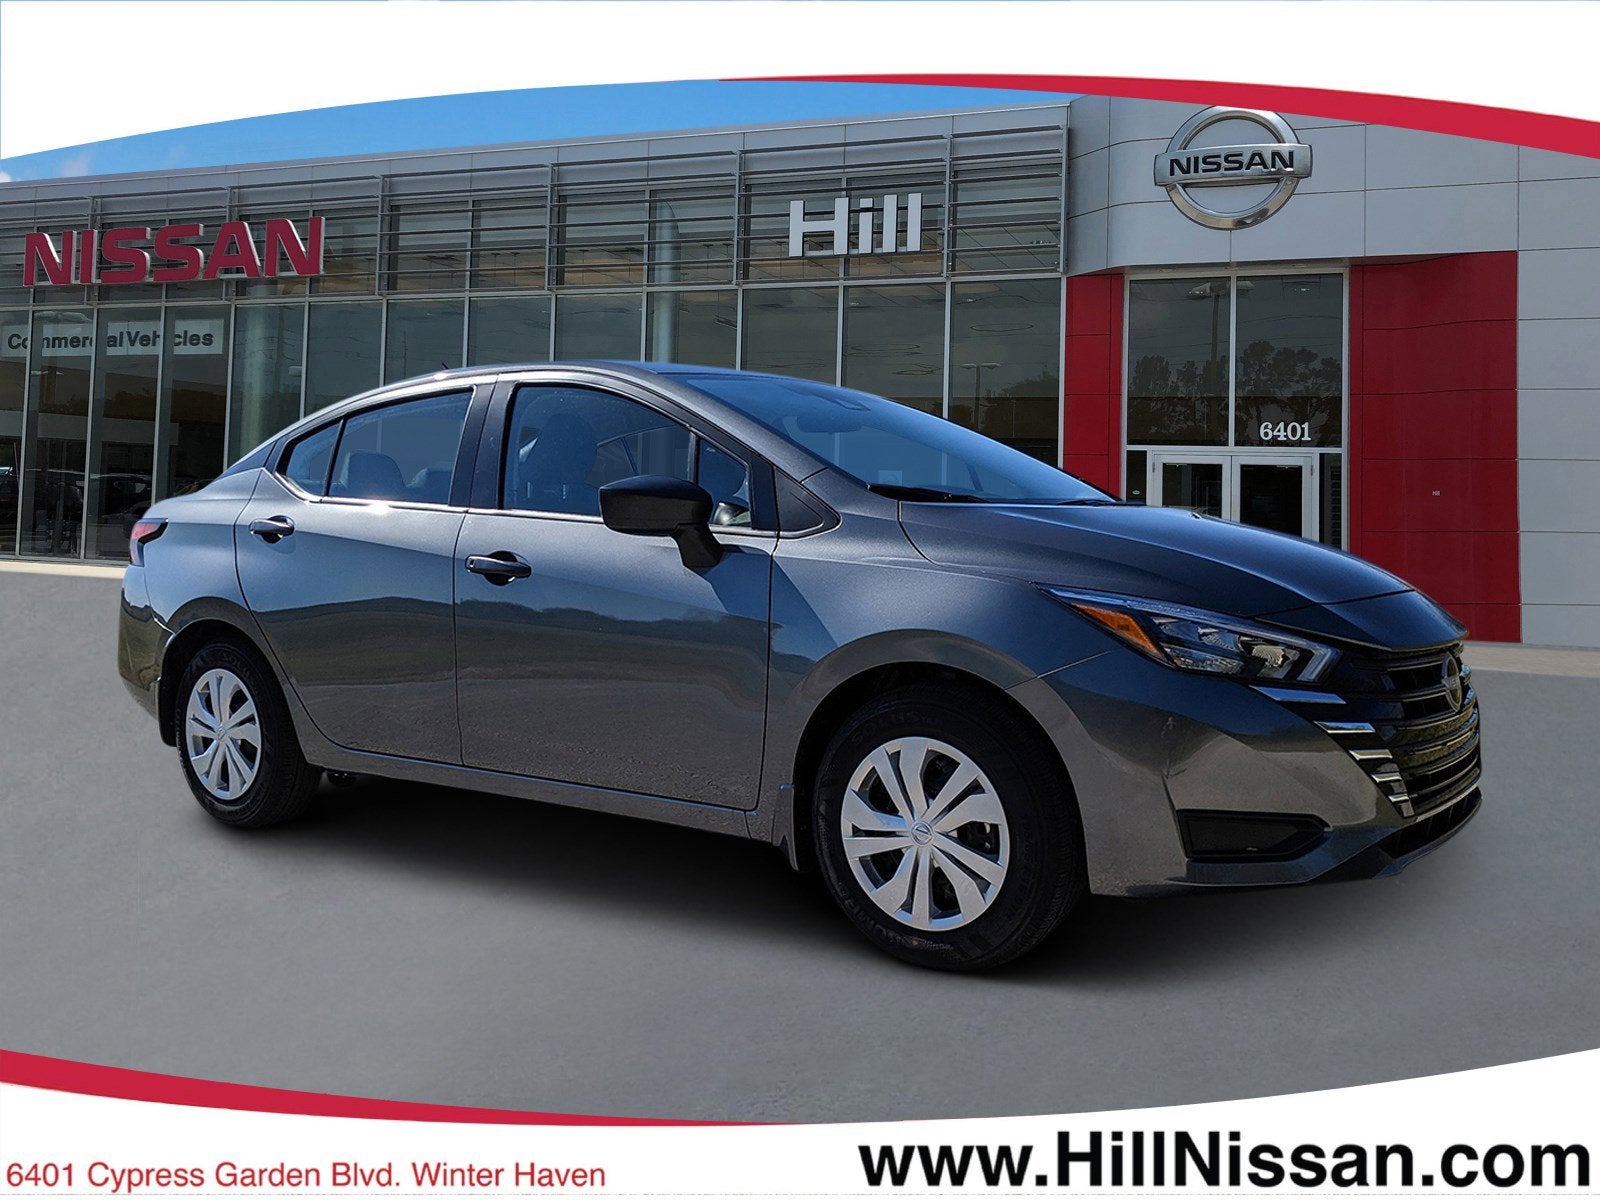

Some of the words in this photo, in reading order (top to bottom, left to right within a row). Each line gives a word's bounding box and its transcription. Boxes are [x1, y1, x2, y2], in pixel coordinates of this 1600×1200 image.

[1169, 150, 1294, 176] NISSAN
[789, 192, 922, 256] Hill
[23, 216, 325, 287] NISSAN
[7, 331, 124, 350] Cmeral
[126, 330, 214, 347] Vehcles
[1260, 421, 1311, 441] 6401
